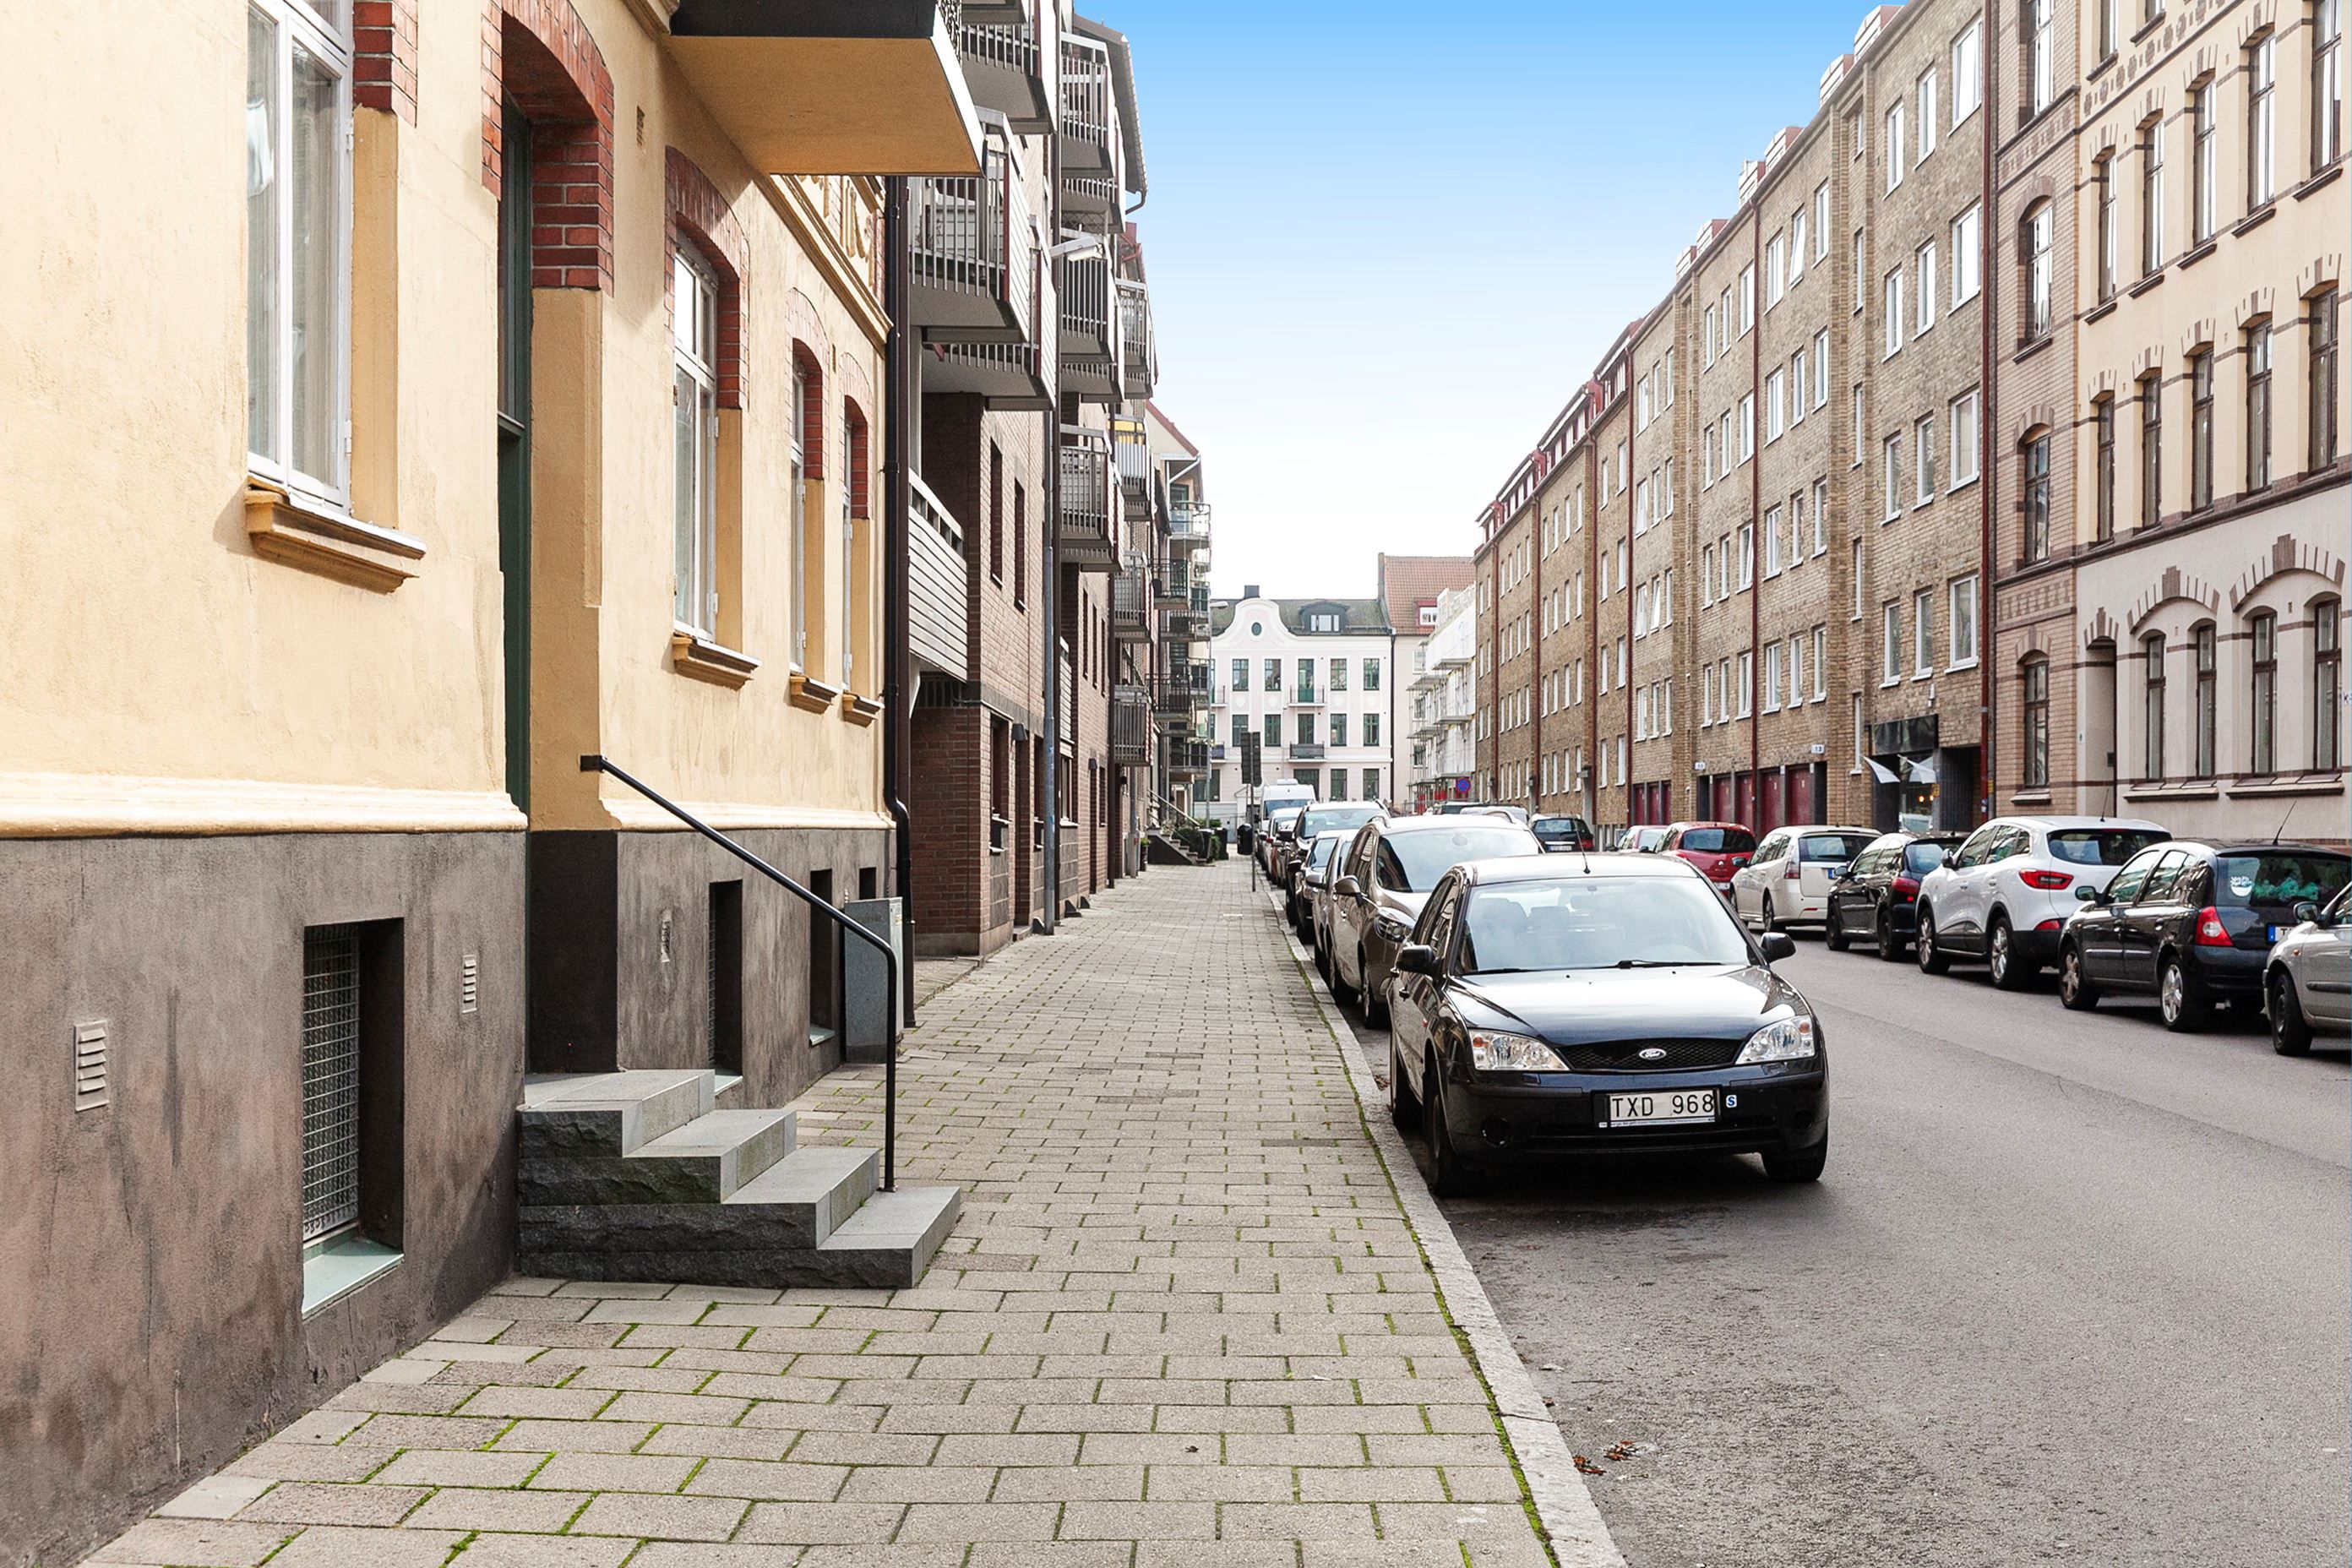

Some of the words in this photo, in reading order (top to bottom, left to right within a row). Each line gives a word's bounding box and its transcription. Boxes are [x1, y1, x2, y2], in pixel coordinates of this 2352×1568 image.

[1612, 1097, 1653, 1118] TXD
[1672, 1093, 1713, 1114] 968
[1727, 1096, 1735, 1107] S
